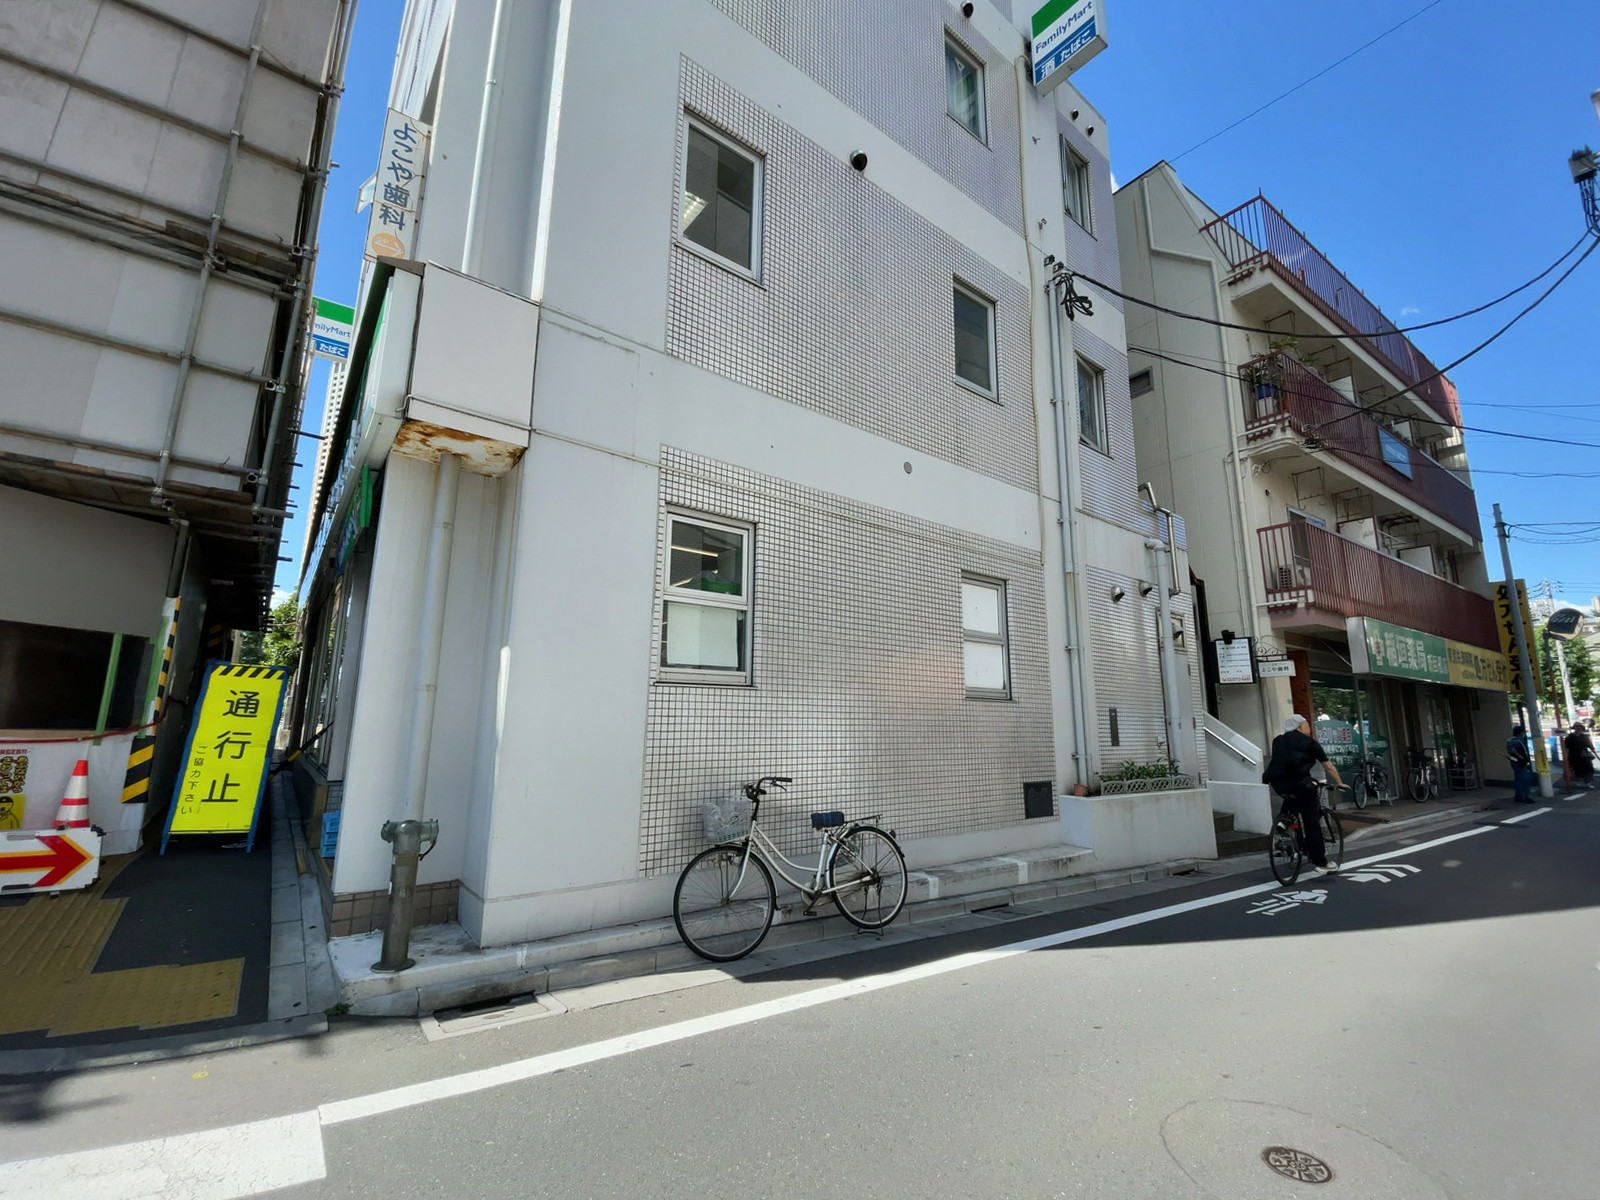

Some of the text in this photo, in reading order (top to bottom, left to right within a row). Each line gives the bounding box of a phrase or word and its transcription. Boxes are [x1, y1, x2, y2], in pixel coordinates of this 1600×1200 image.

[1035, 1, 1093, 54] FamilyMart
[1060, 29, 1092, 63] たばこ
[379, 122, 417, 231] よこや歯科
[314, 322, 352, 338] milyMart
[320, 343, 346, 357] たばこ
[1261, 665, 1290, 673] よこや歯科
[200, 689, 260, 803] 通行止
[180, 745, 207, 815] ご協力下さい
